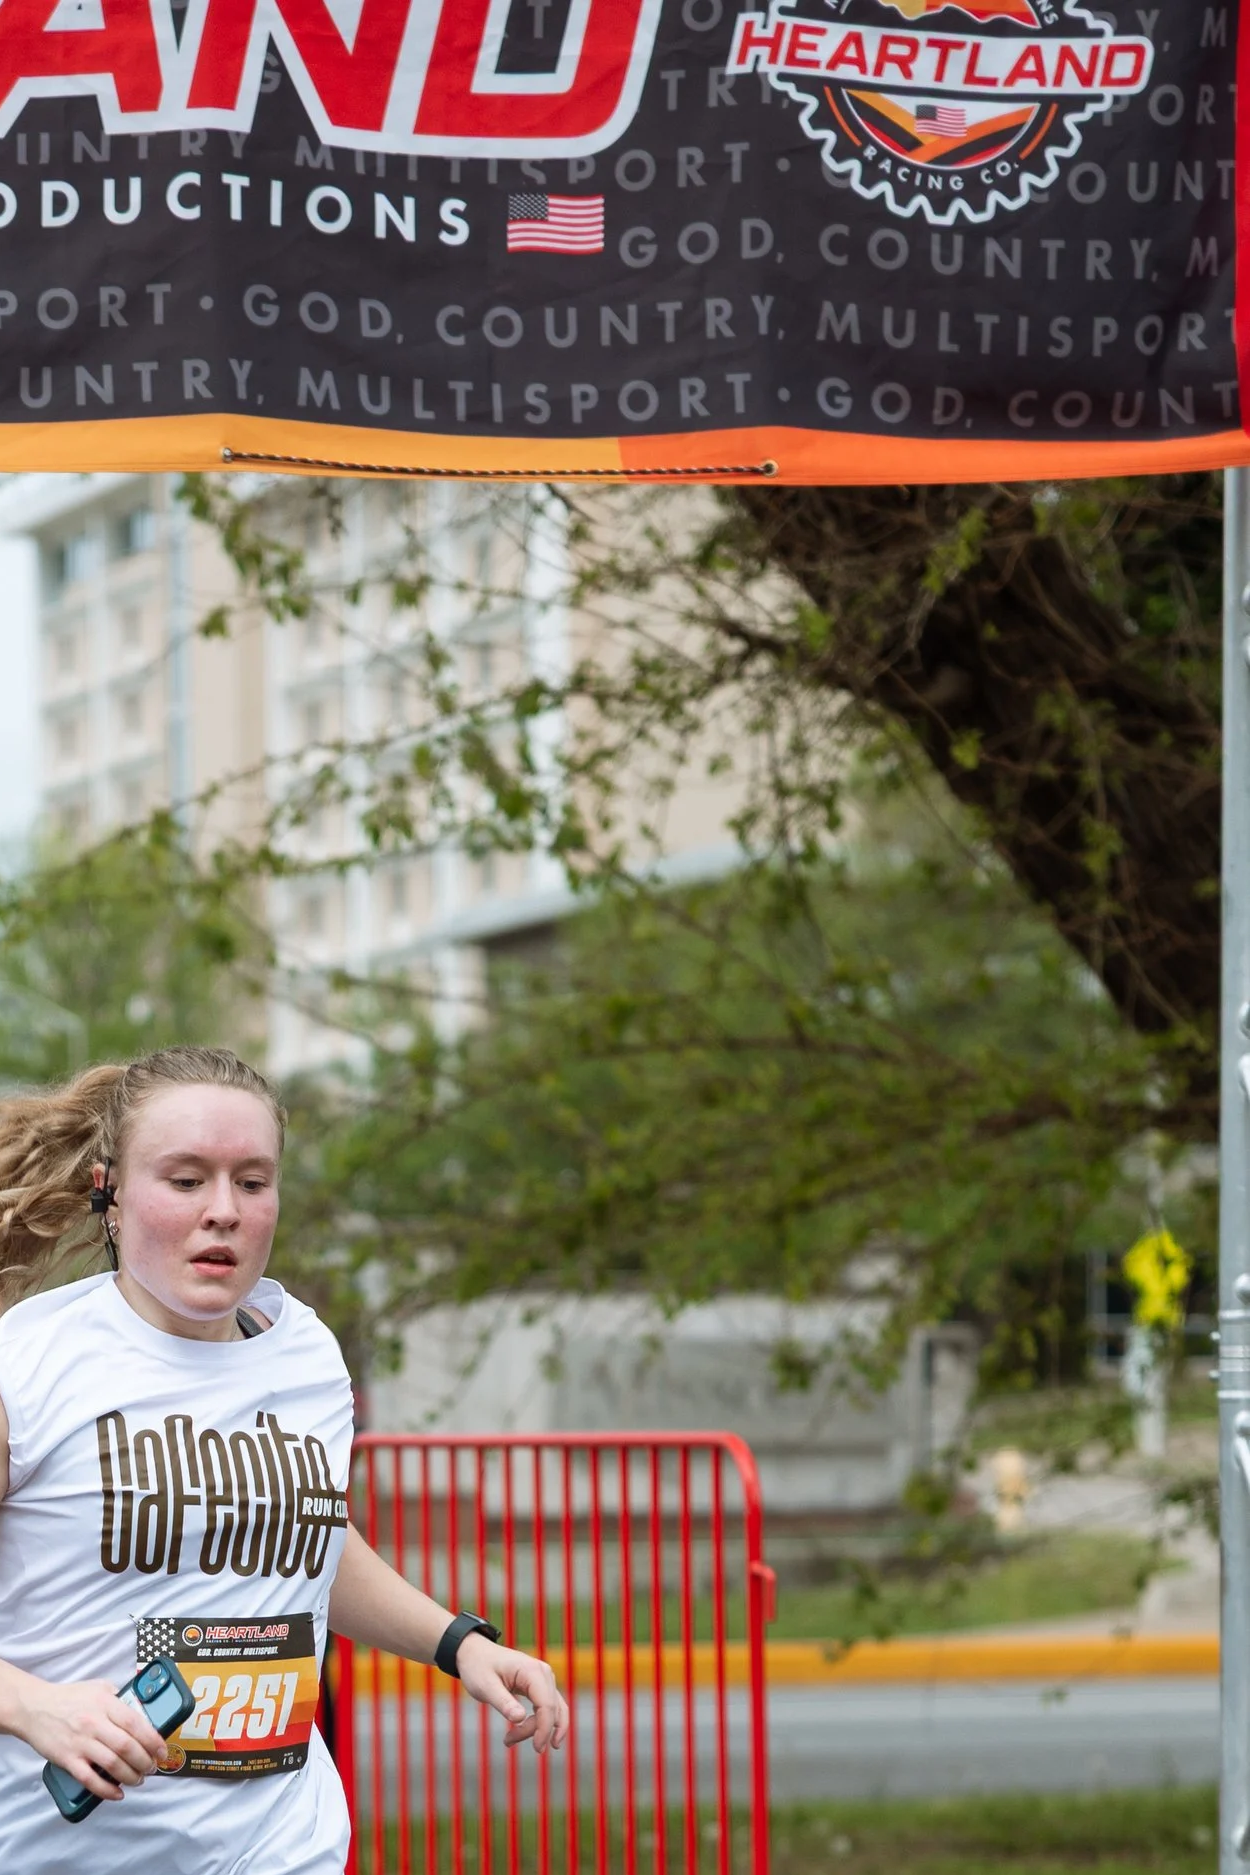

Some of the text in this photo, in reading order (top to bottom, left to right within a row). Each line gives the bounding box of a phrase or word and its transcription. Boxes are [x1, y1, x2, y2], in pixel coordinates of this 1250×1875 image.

[736, 19, 1148, 89] HEARTLAND
[862, 144, 966, 191] RACING
[979, 160, 1021, 185] CO.
[1026, 159, 1236, 204] OUNT
[620, 217, 785, 270] GOD,
[818, 222, 1158, 283] COUNTRY,
[242, 283, 406, 346] GOD,
[435, 293, 786, 349] COUNTRY,
[297, 365, 753, 425] MULTISPORT
[815, 376, 974, 430] GOD,
[302, 1496, 349, 1519] RUN CLU
[205, 1623, 289, 1639] HEARTLAND
[179, 1671, 299, 1741] 2251
